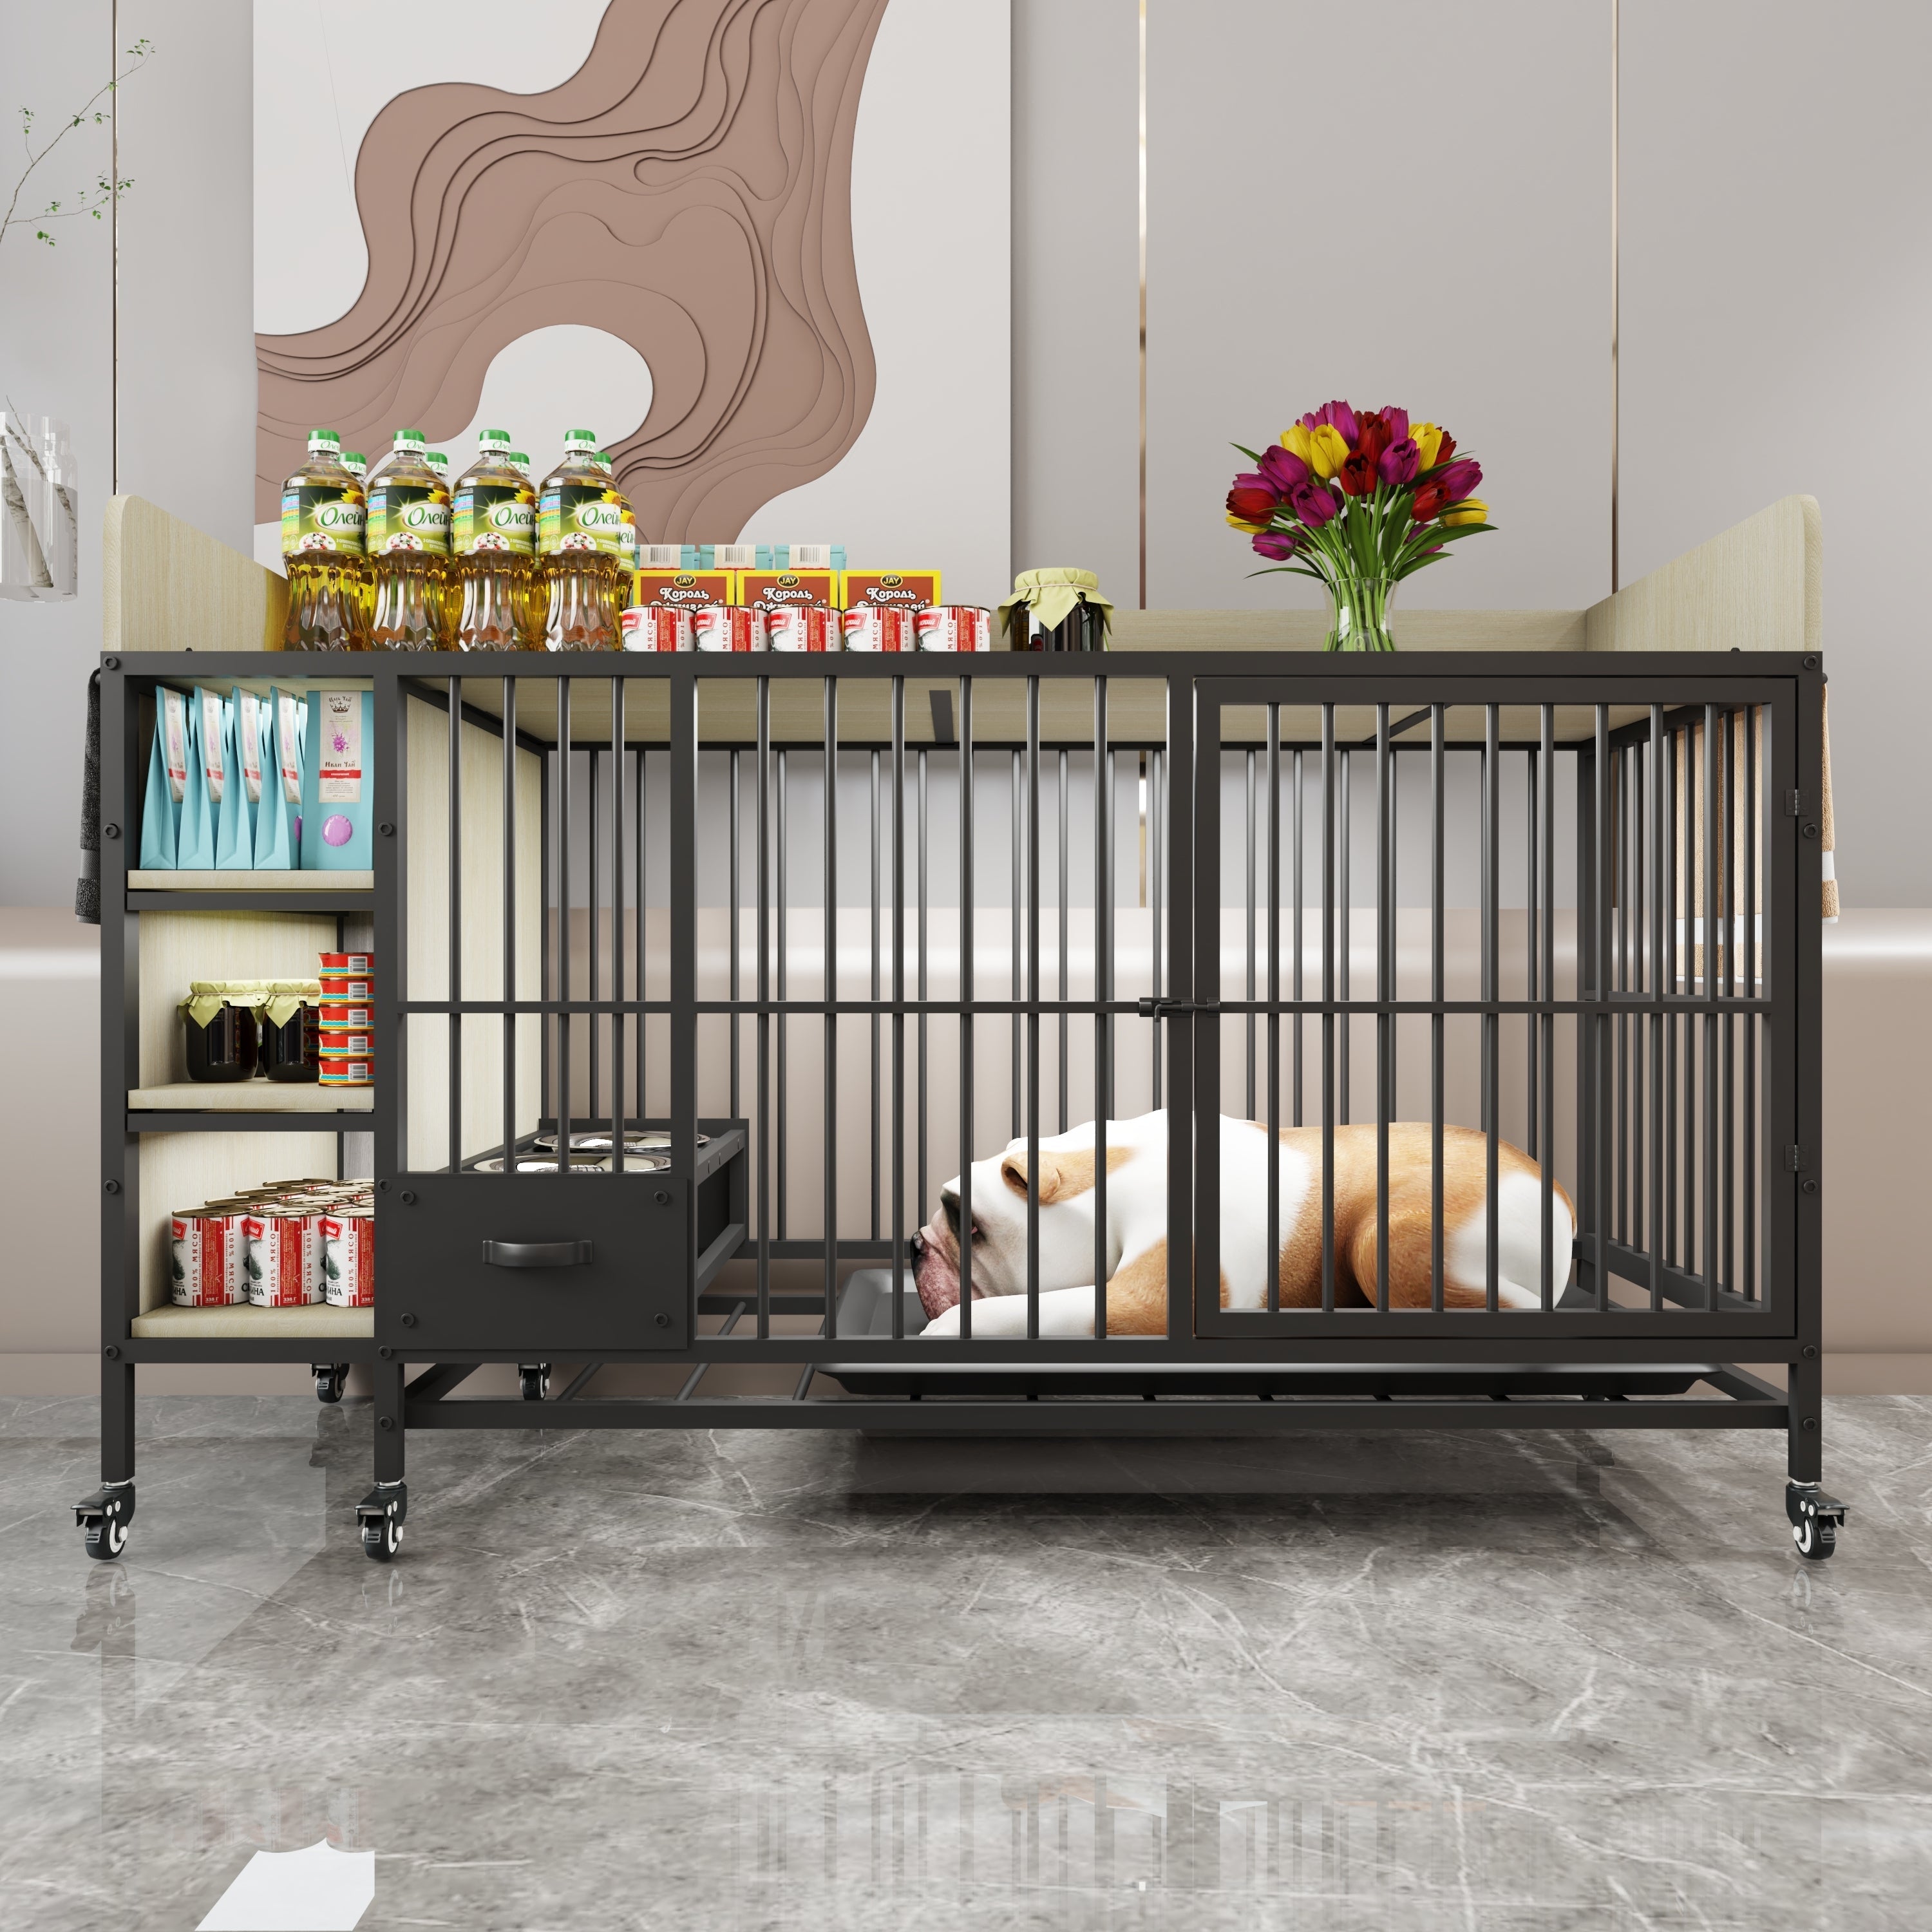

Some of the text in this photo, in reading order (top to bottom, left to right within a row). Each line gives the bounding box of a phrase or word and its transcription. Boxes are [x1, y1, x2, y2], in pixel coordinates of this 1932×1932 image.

[659, 587, 710, 602] Король
[762, 587, 813, 602] Король
[866, 587, 916, 602] Король
